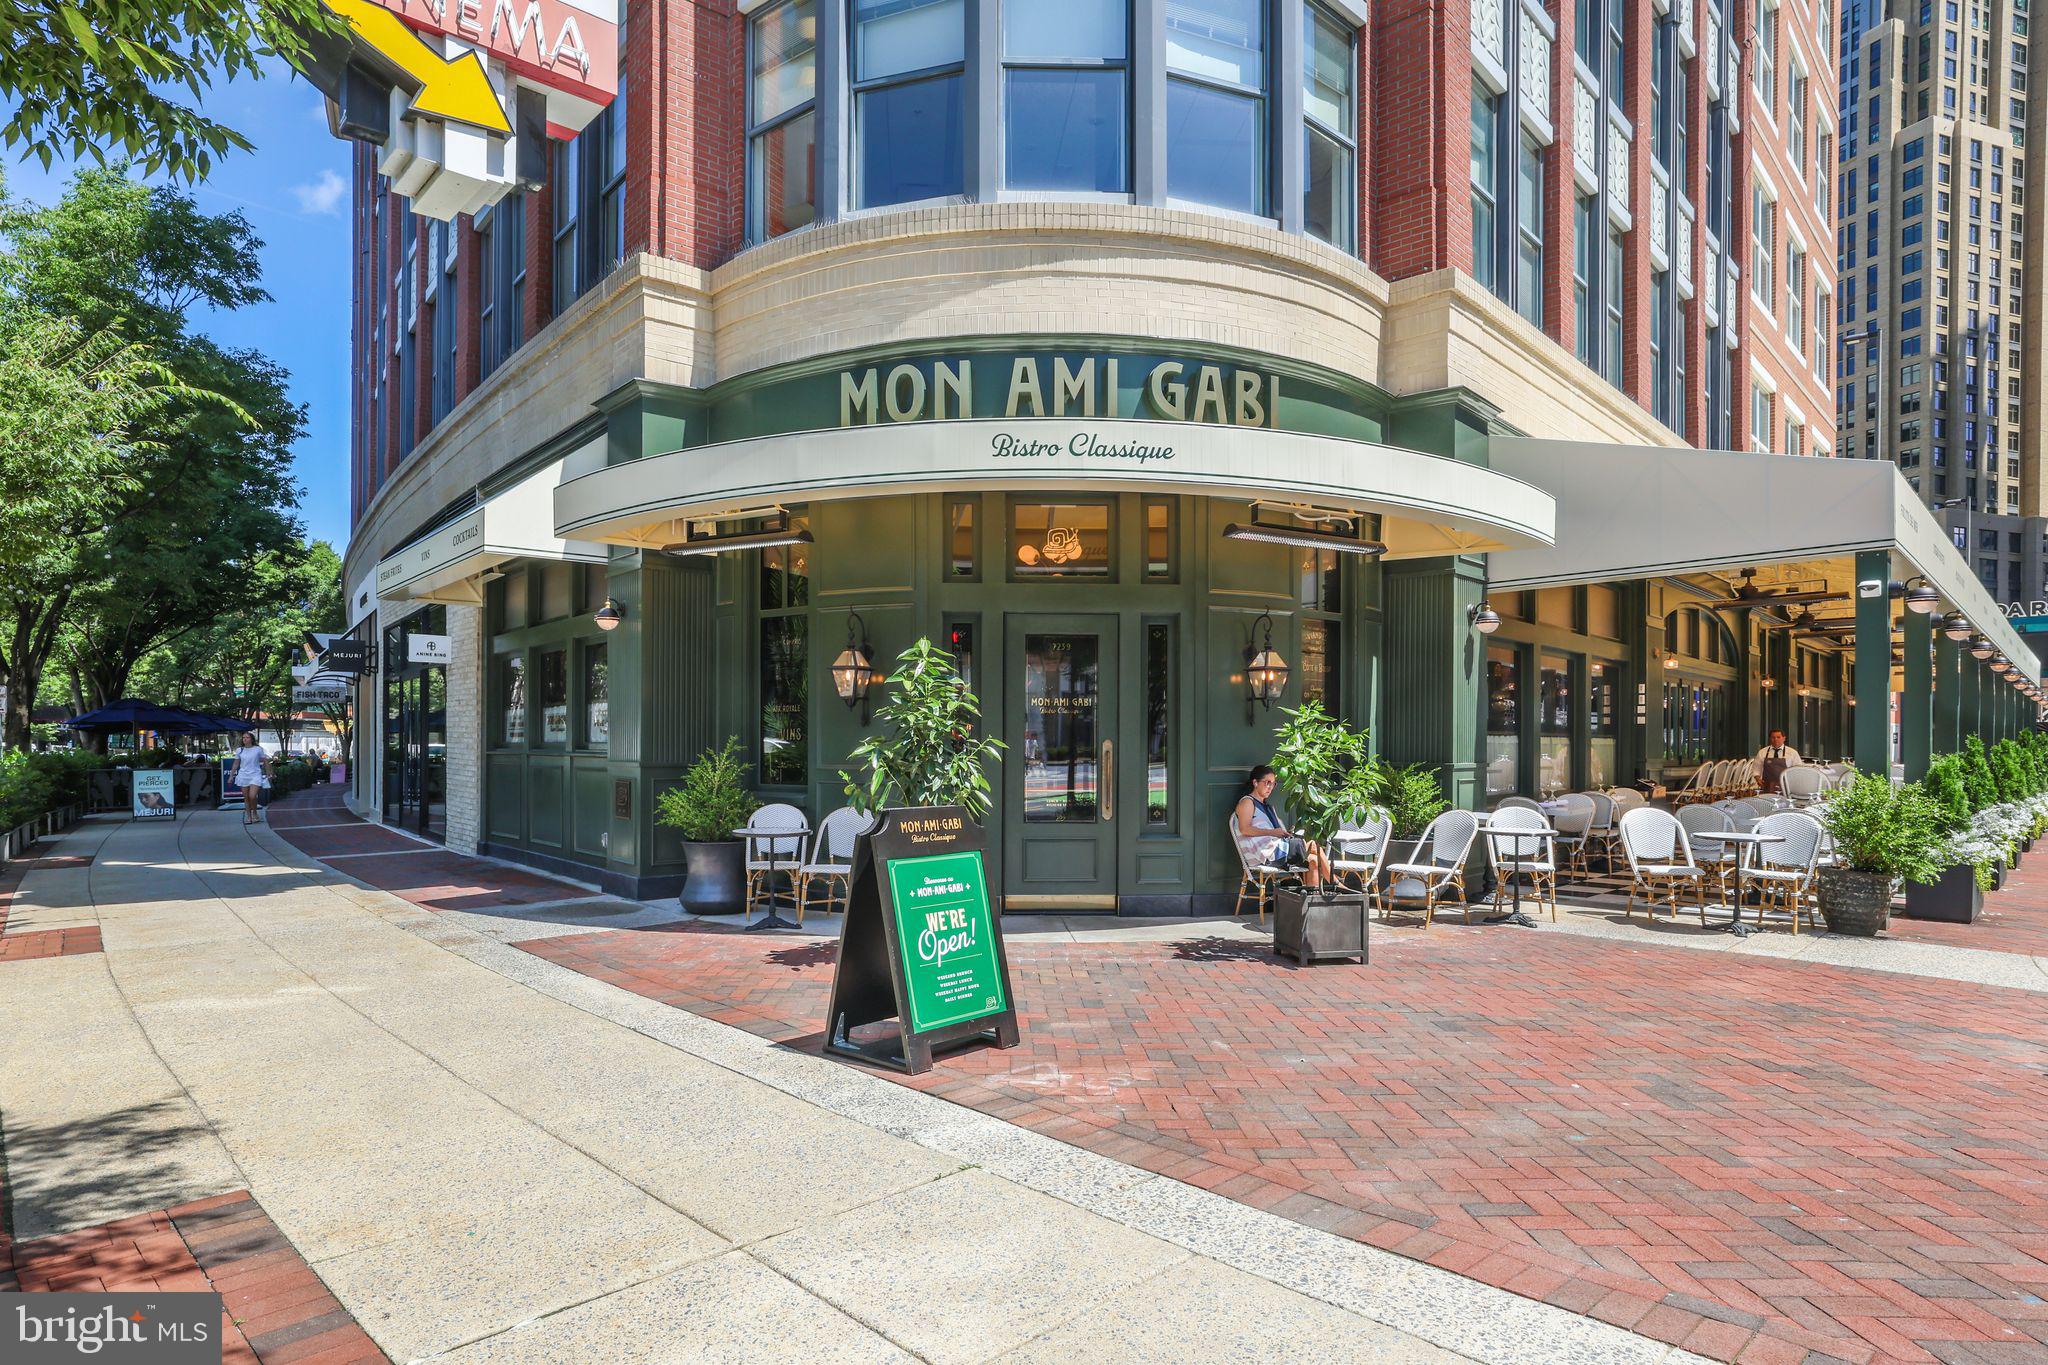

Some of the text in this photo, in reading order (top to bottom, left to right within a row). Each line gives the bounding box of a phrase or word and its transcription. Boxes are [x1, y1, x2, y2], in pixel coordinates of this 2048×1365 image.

[841, 357, 1280, 429] MON AMI GABI
[991, 432, 1175, 465] Bistro Classique
[452, 525, 479, 547] COCKTAILS
[296, 690, 340, 699] FISH TACO
[134, 807, 174, 817] MEJURI
[925, 908, 968, 933] WE'RE
[918, 917, 976, 968] Open!
